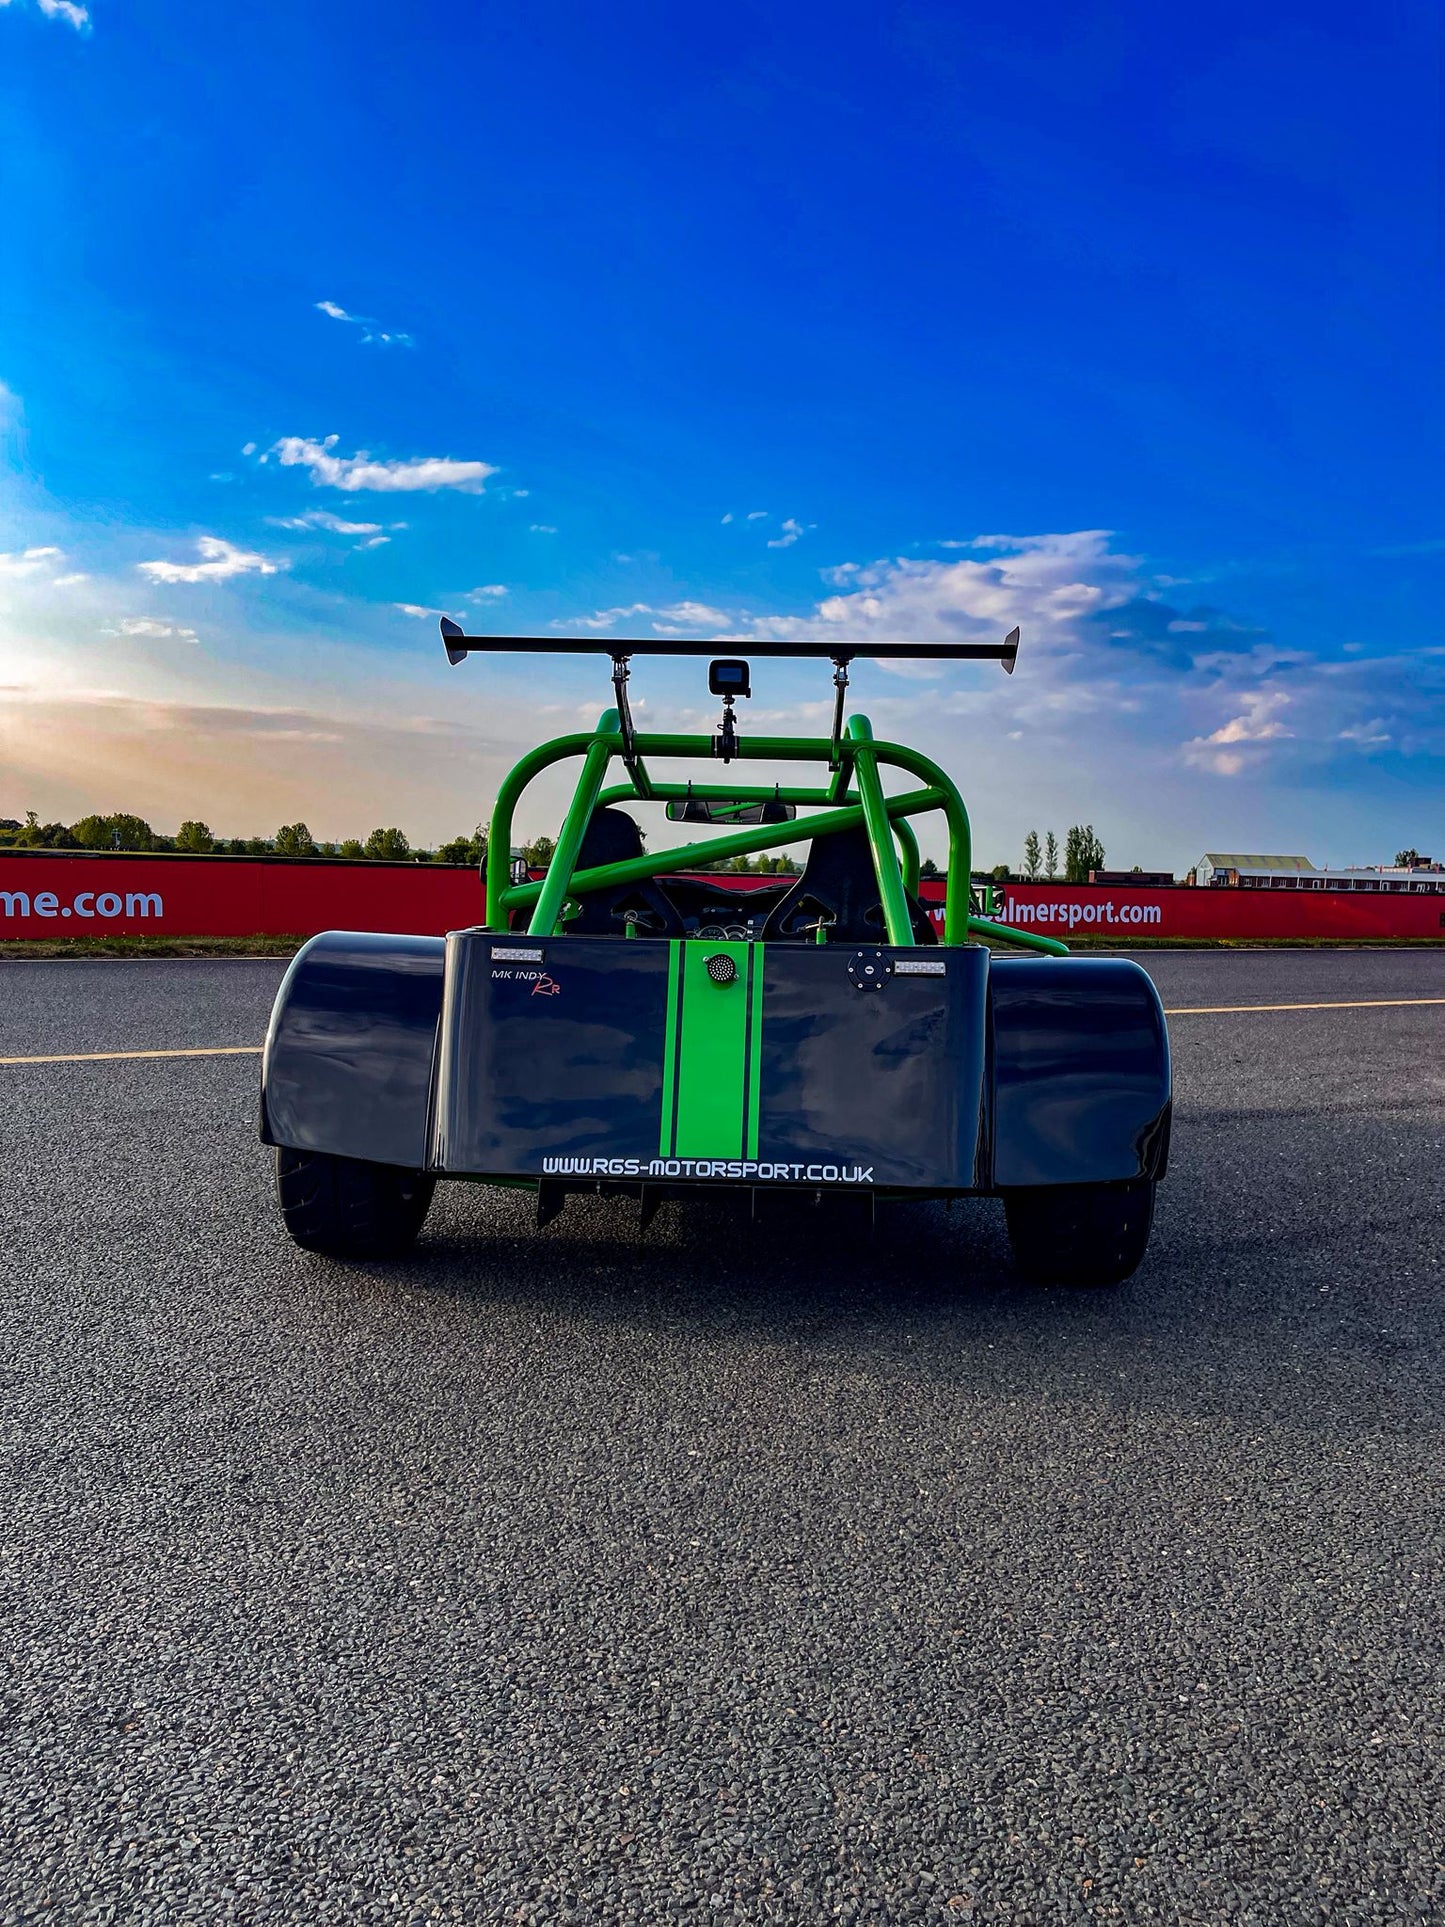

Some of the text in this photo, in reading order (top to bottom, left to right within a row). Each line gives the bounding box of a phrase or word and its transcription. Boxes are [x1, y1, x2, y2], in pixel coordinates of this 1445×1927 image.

[0, 891, 164, 917] me.com
[491, 970, 548, 981] MK INDY
[542, 1157, 874, 1183] WWW.RGS-MOTORSPORT.CO.UK
